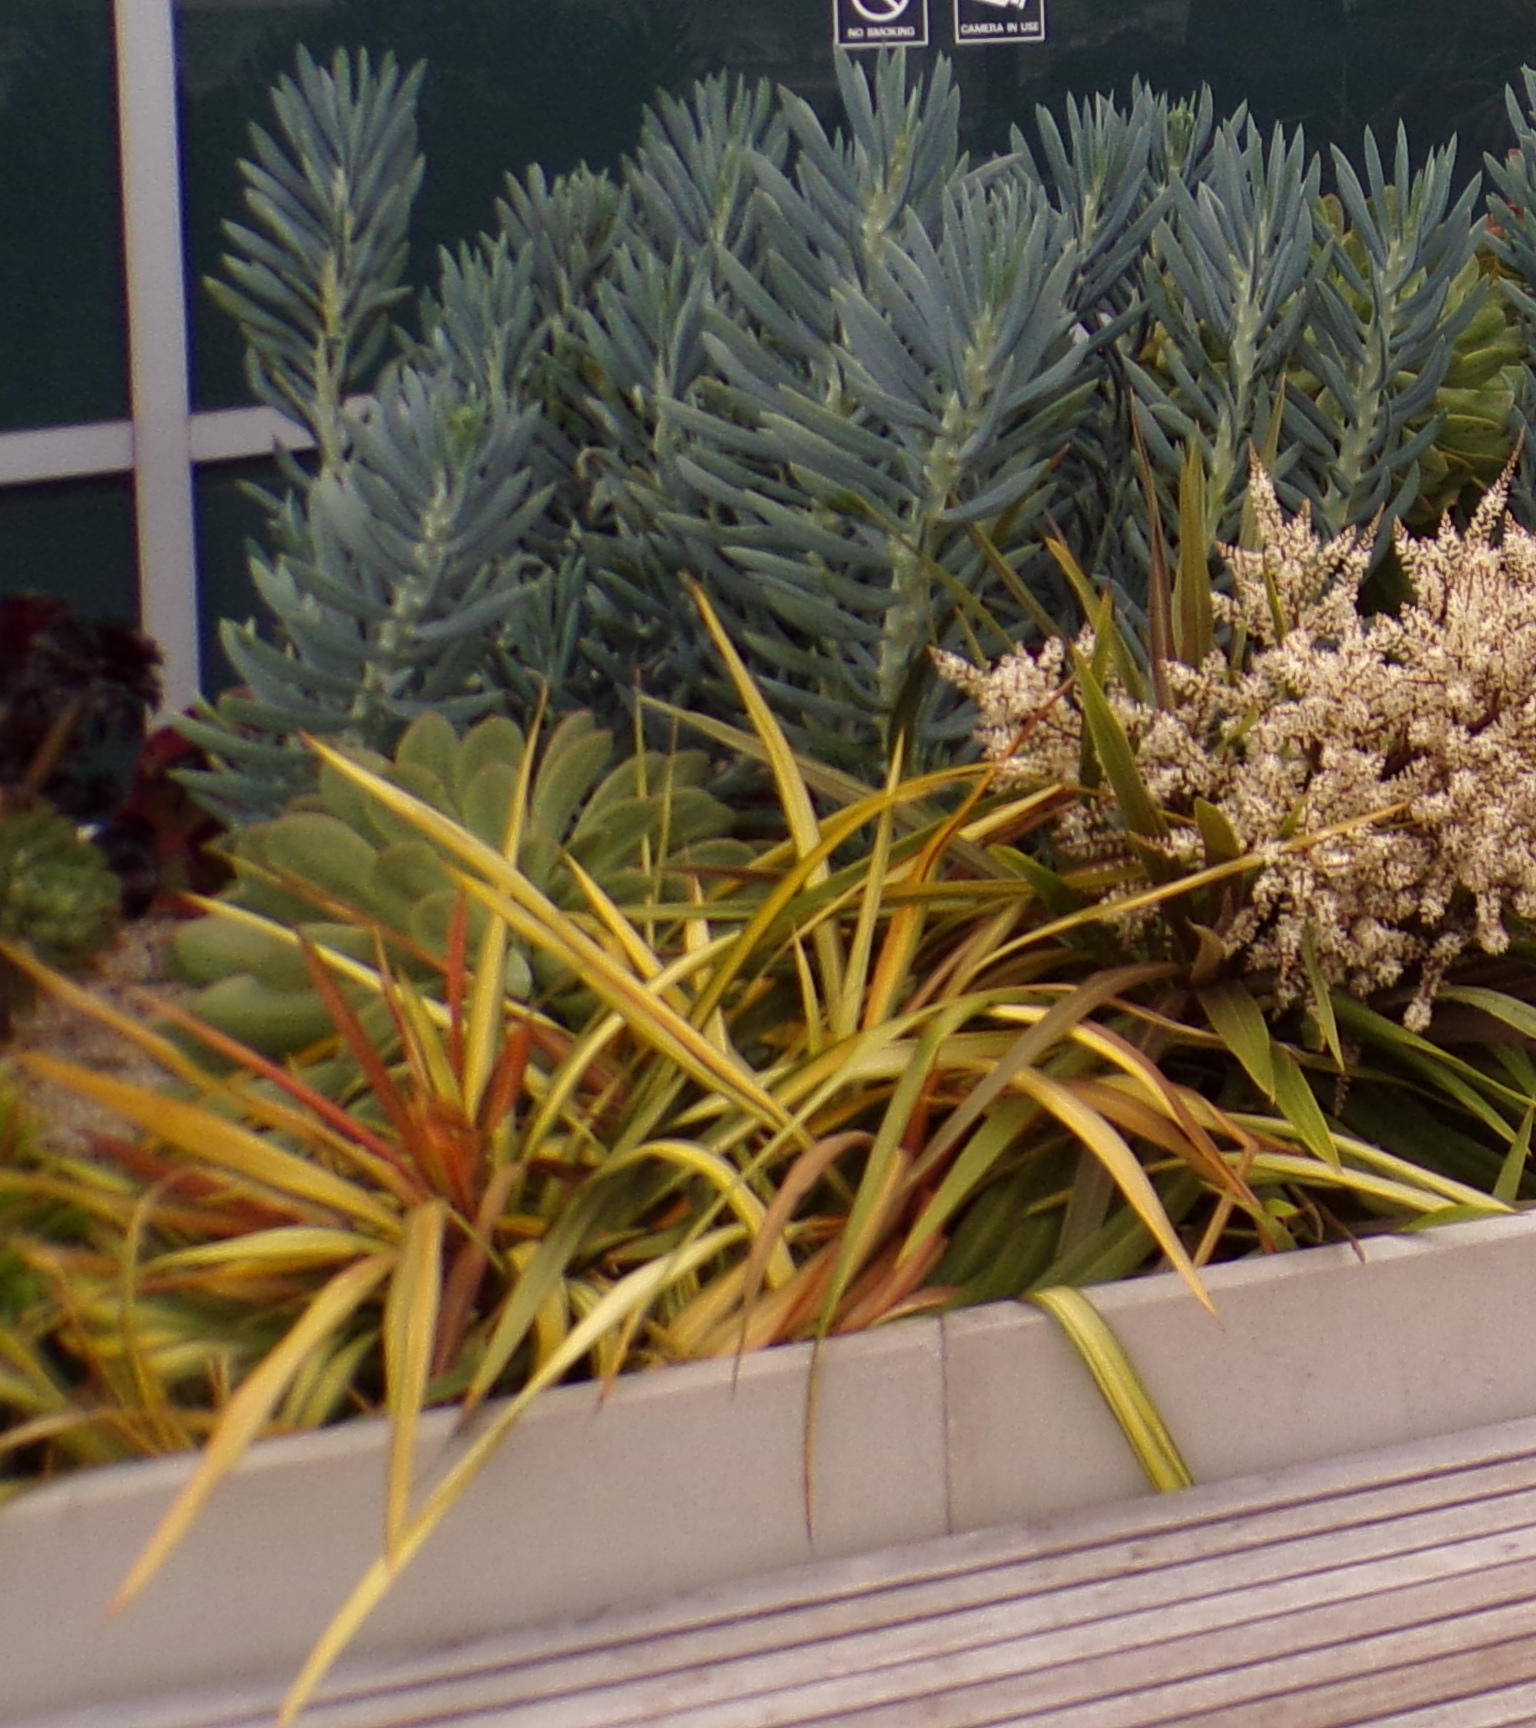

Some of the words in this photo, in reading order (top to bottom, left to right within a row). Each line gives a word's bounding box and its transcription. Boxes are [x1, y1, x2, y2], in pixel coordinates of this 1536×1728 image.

[847, 27, 865, 39] NO
[867, 26, 916, 39] SMOKING
[961, 22, 1004, 35] CAMERA
[1007, 22, 1018, 33] IN
[1020, 21, 1040, 32] USE
